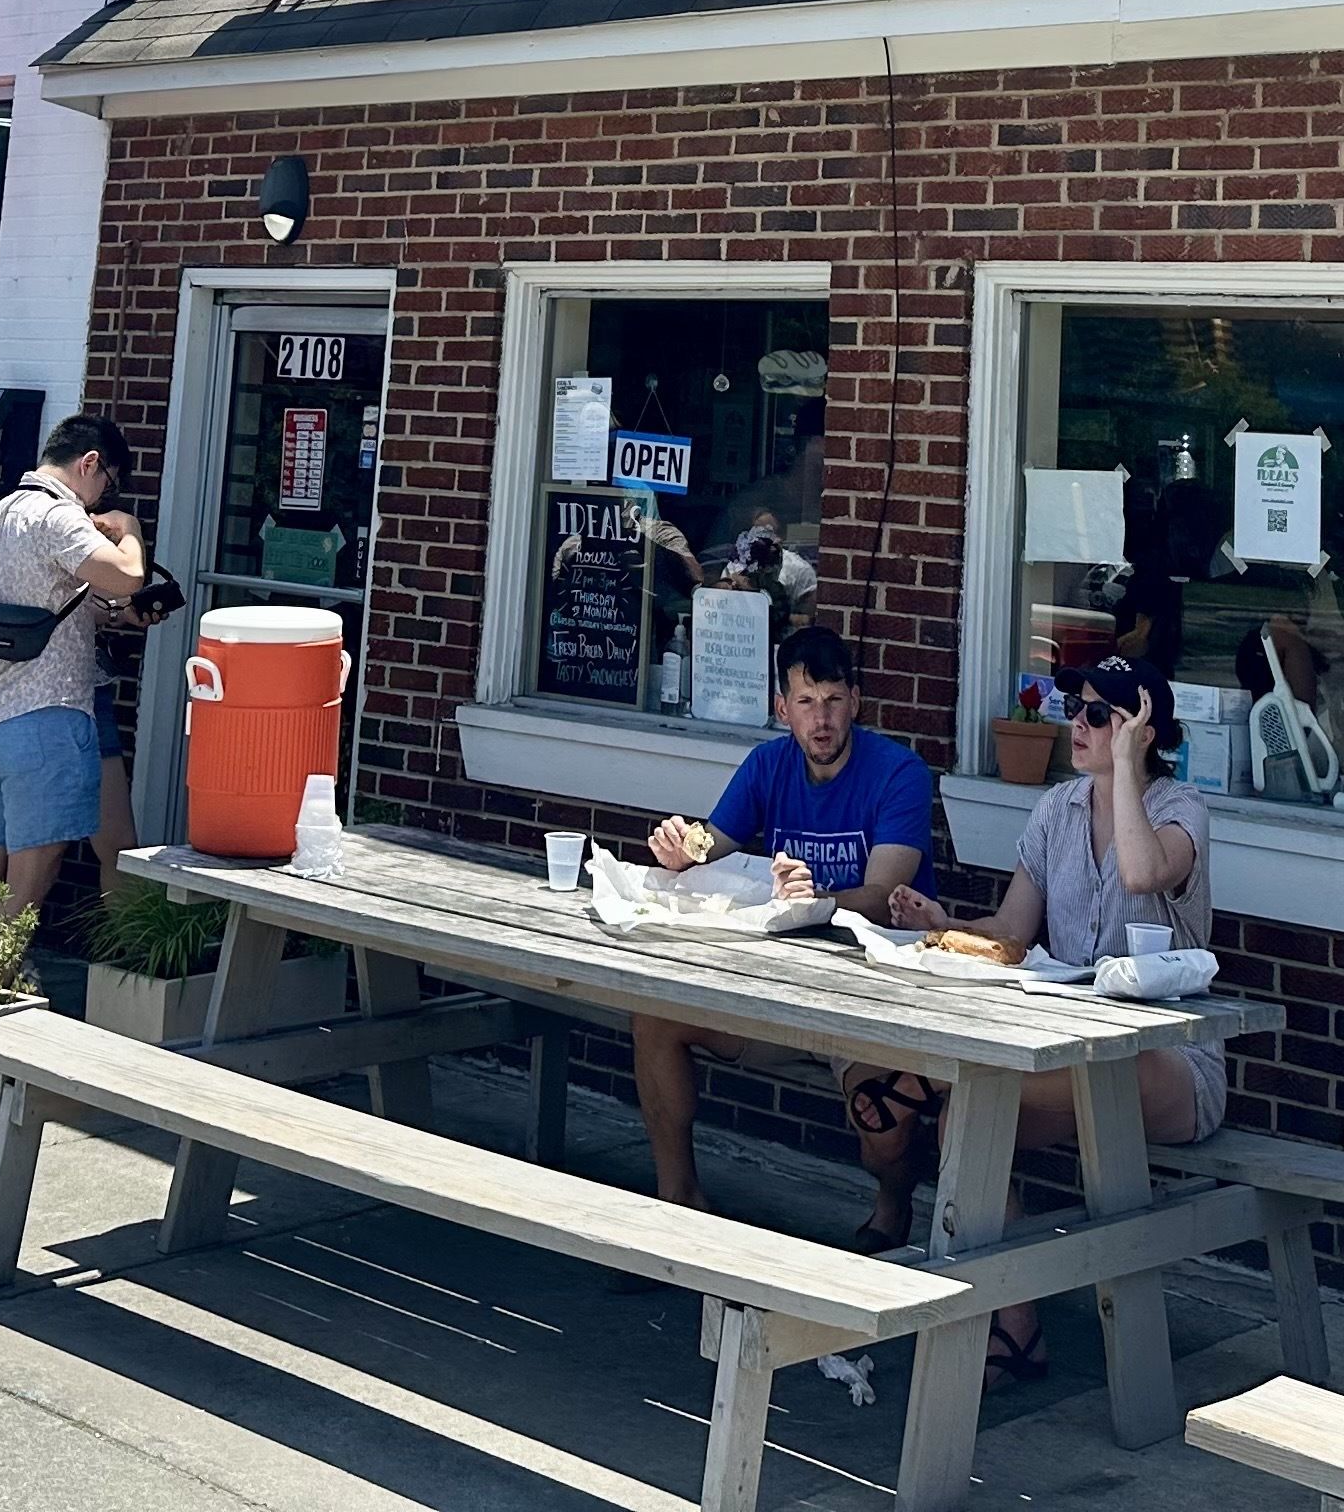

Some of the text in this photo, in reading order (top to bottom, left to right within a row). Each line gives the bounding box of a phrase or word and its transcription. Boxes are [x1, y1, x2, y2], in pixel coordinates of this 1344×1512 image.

[278, 336, 344, 379] 2108
[620, 441, 684, 484] OPEN
[1256, 469, 1299, 483] IDEAL'S
[355, 540, 364, 579] PULL
